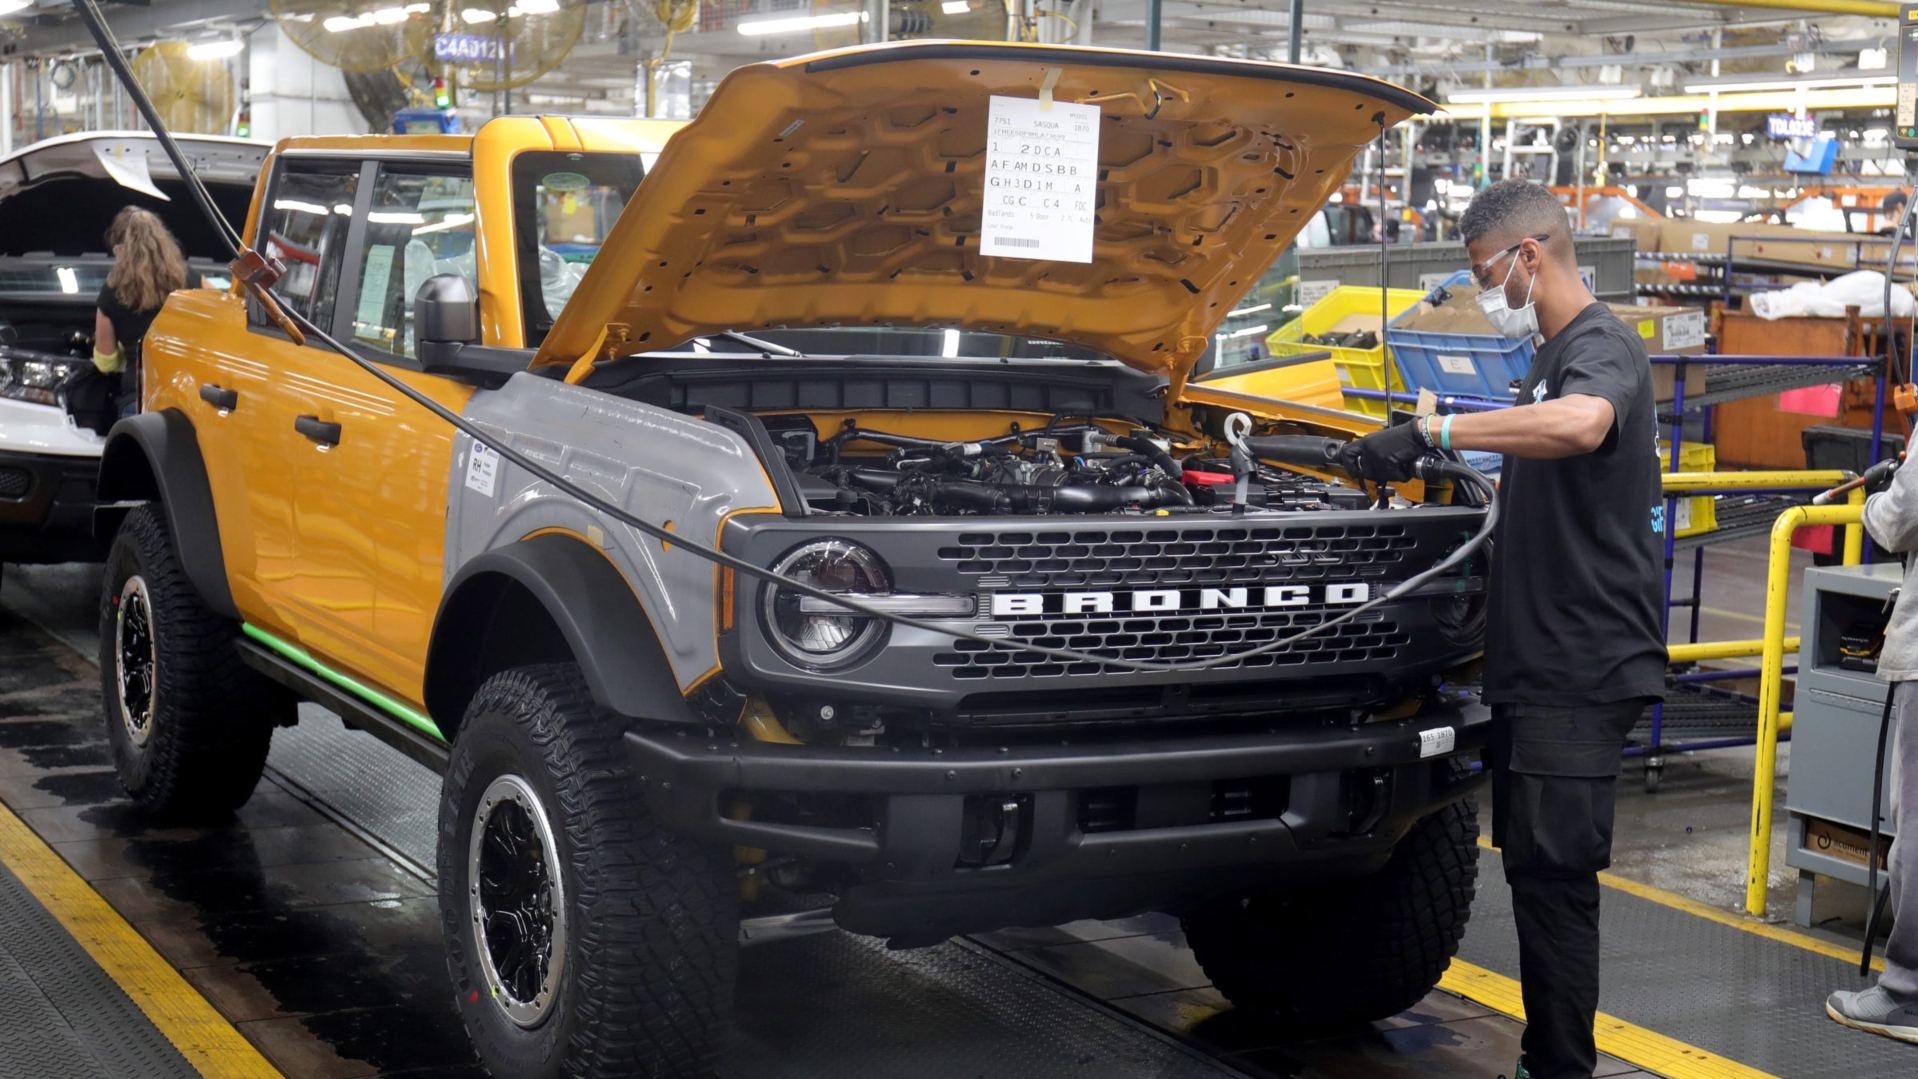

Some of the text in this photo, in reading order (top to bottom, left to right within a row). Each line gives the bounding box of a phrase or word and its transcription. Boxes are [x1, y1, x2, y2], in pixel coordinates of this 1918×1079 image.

[993, 117, 1011, 125] 7751
[1033, 120, 1059, 129] SASQUA
[1074, 124, 1090, 132] 1870
[987, 209, 1015, 218] Badlands
[1036, 212, 1050, 220] Door
[1079, 216, 1092, 224] Auto
[1450, 358, 1462, 370] E
[472, 457, 482, 473] RH
[992, 583, 1369, 615] BRONCO
[1422, 729, 1453, 743] 165 1870
[1833, 839, 1868, 857] acument
